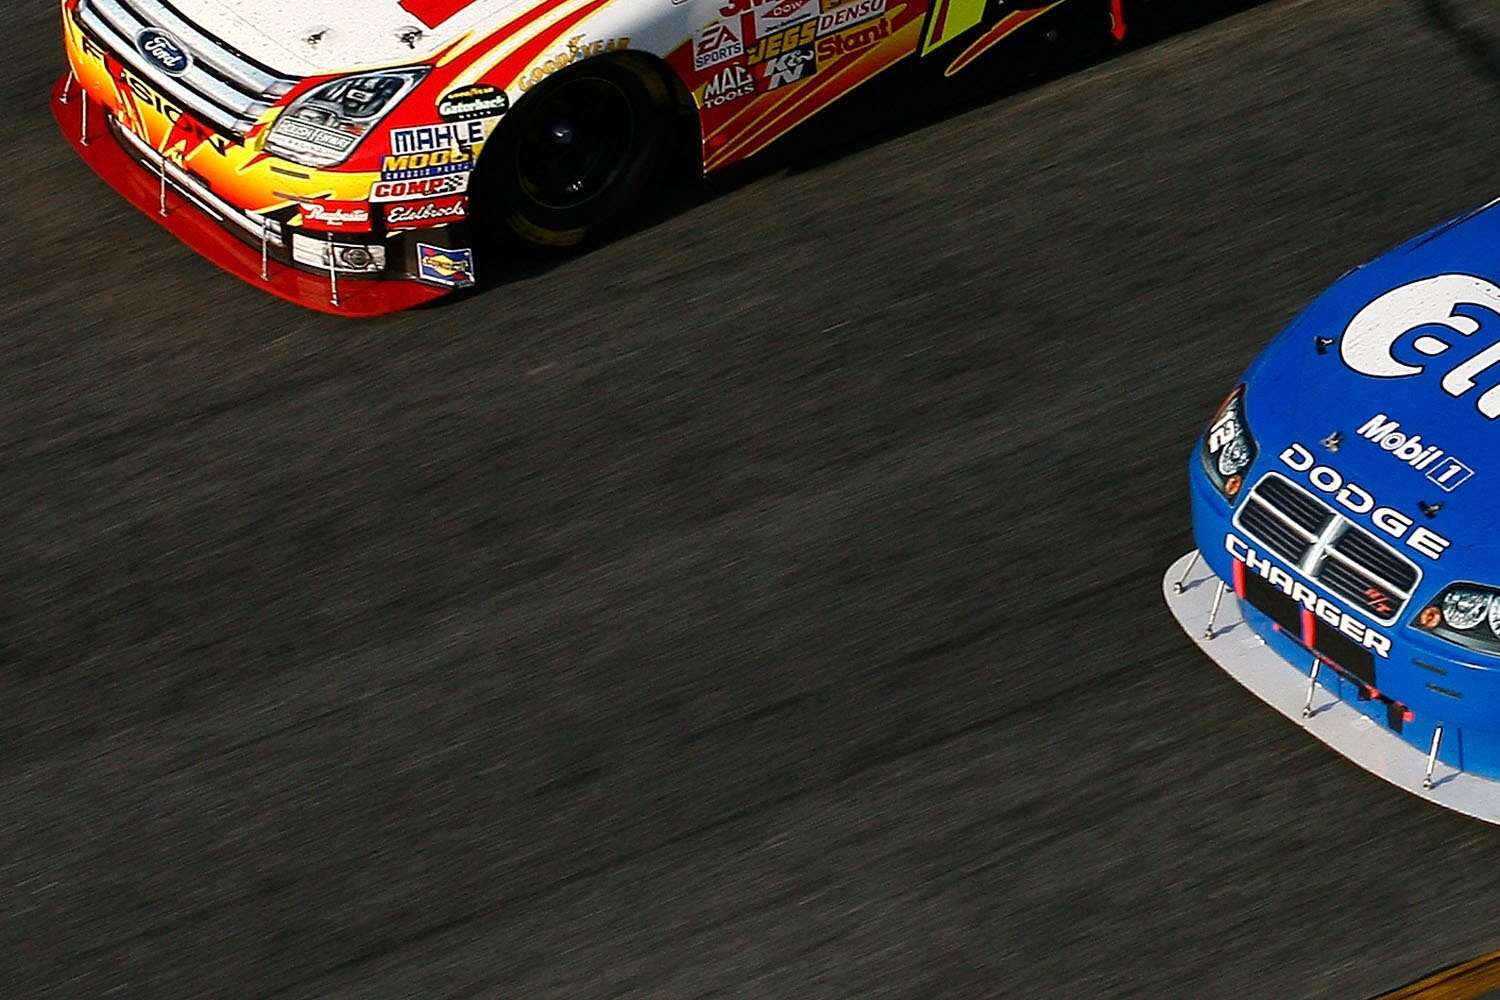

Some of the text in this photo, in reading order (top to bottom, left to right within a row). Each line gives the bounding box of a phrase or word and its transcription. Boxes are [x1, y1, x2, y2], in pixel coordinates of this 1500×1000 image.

[144, 36, 183, 67] Ford
[748, 20, 817, 65] JEGS
[818, 16, 889, 61] Stant
[696, 43, 741, 68] SPORTS
[704, 64, 752, 99] MAC
[704, 83, 755, 108] TOOLS
[394, 121, 484, 153] MAHLE
[375, 179, 445, 197] COMP
[387, 201, 465, 223] Edelbrock
[1356, 413, 1445, 471] Mobil
[1279, 443, 1451, 560] DODGE
[1224, 533, 1393, 659] CHARGER
